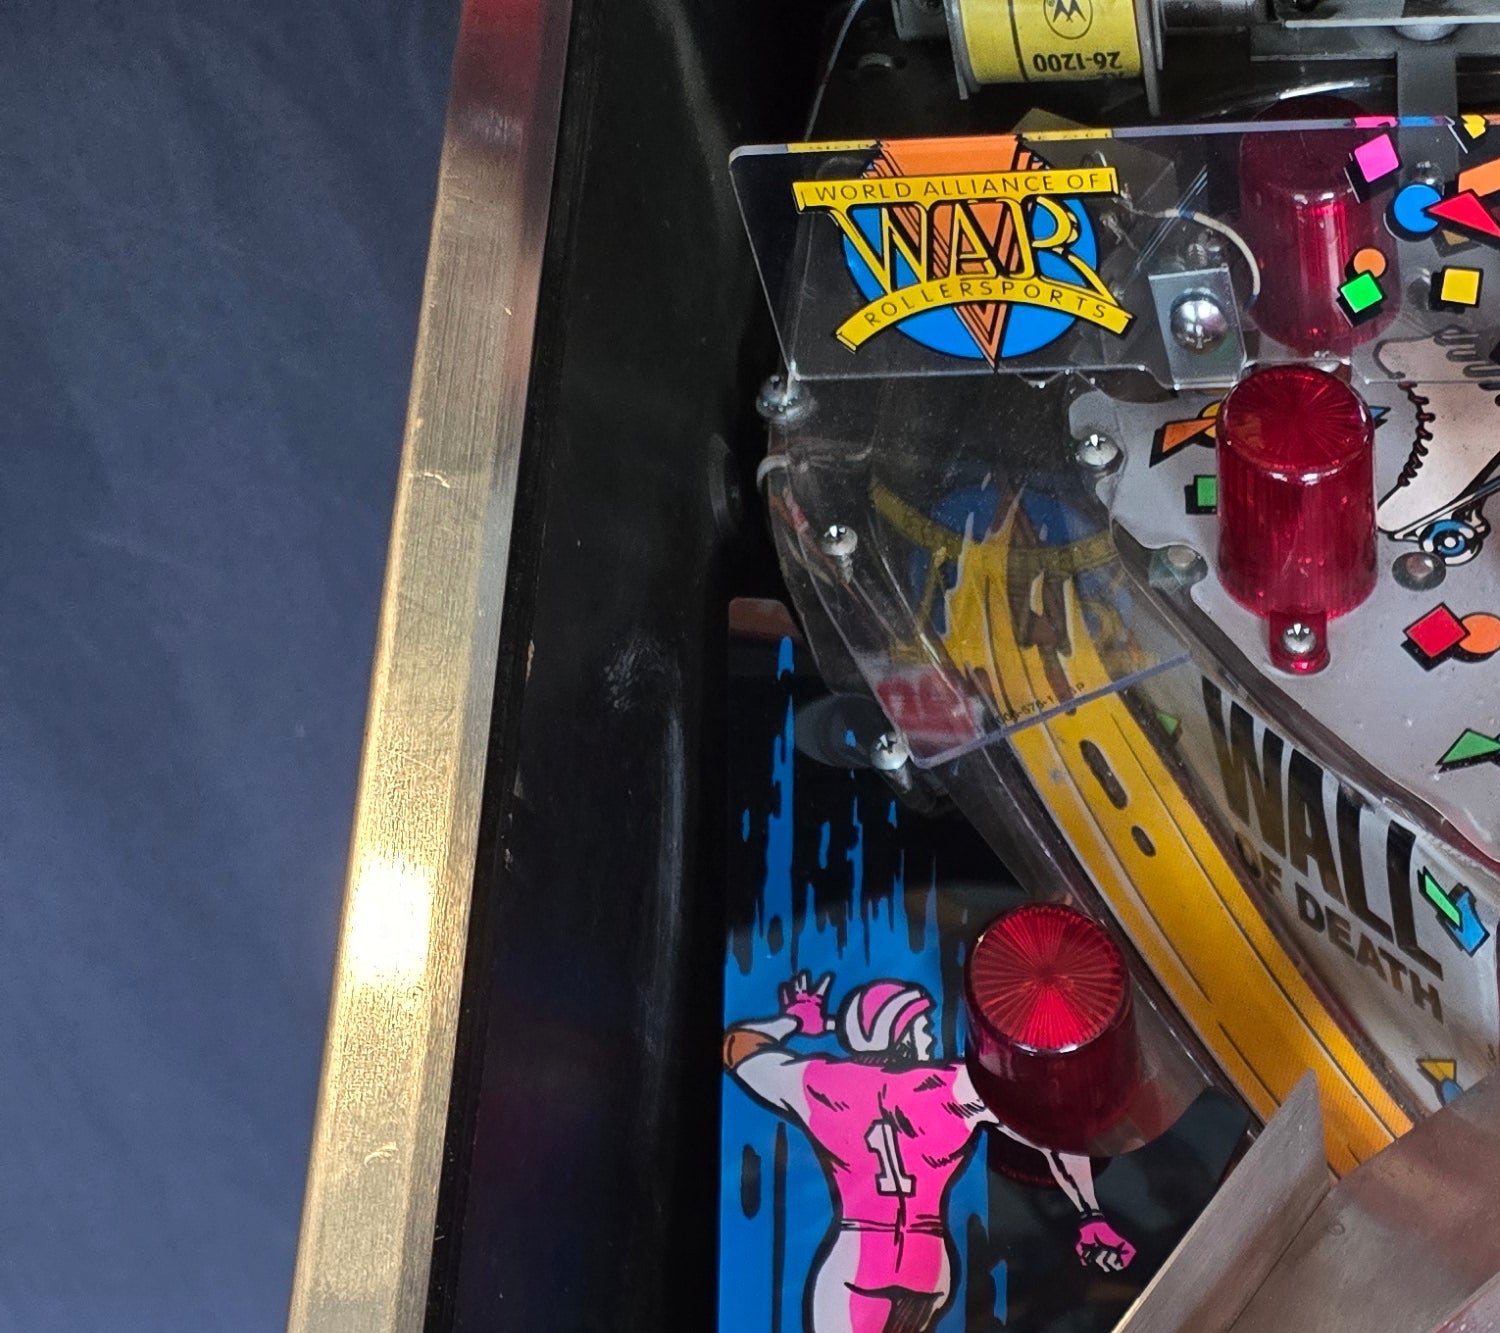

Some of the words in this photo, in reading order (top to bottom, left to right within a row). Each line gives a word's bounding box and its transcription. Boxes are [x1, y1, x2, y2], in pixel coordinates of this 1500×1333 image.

[1031, 51, 1123, 73] 26-1200
[815, 183, 912, 201] WORLD
[924, 176, 1053, 196] ALLIANCE
[1068, 174, 1099, 189] OF
[829, 196, 1118, 307] WAR
[864, 281, 1107, 328] ROLLERSPORTS
[1201, 675, 1445, 982] WALL
[1295, 881, 1445, 1025] DEATH
[866, 1121, 916, 1198] 1
